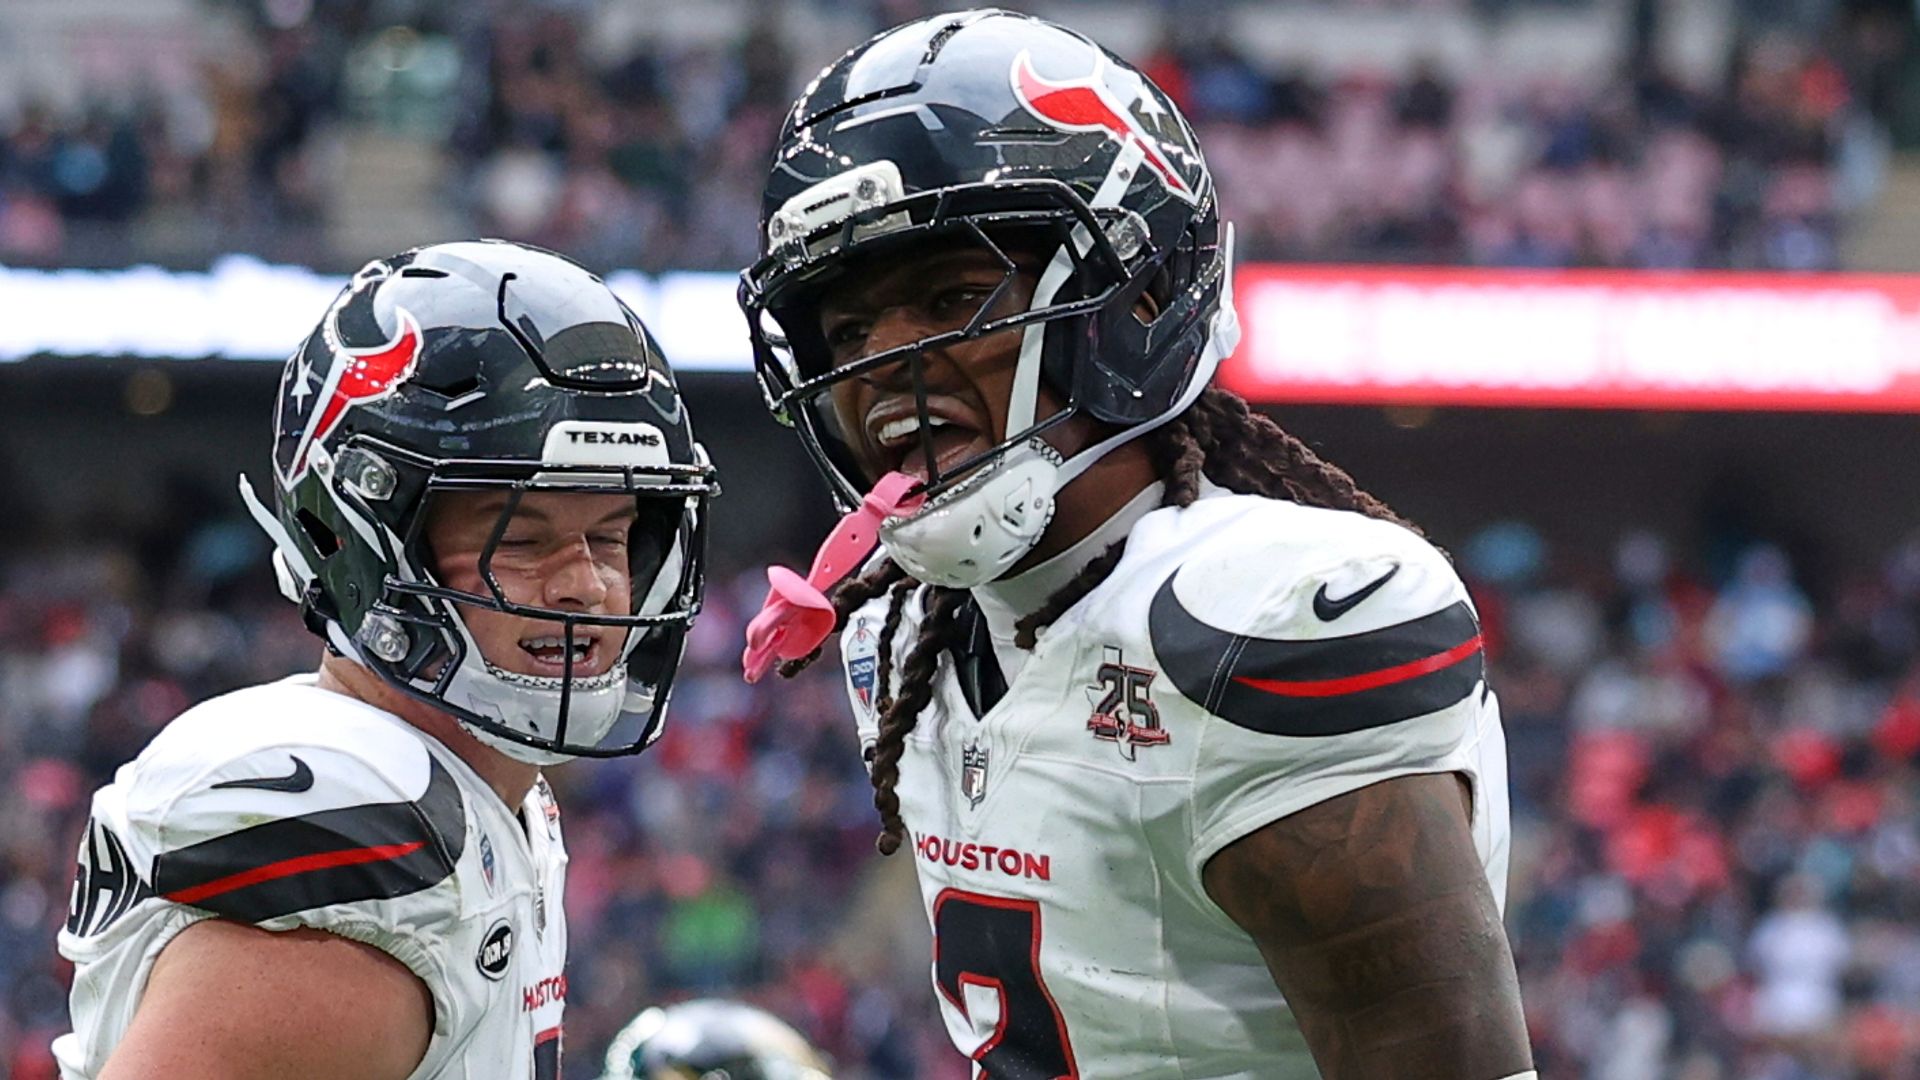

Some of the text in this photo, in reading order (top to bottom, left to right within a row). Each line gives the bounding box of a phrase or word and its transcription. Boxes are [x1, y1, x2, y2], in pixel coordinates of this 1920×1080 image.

[565, 431, 660, 447] TEXANS
[1096, 663, 1160, 741] 25
[915, 831, 1050, 880] HOUSTON
